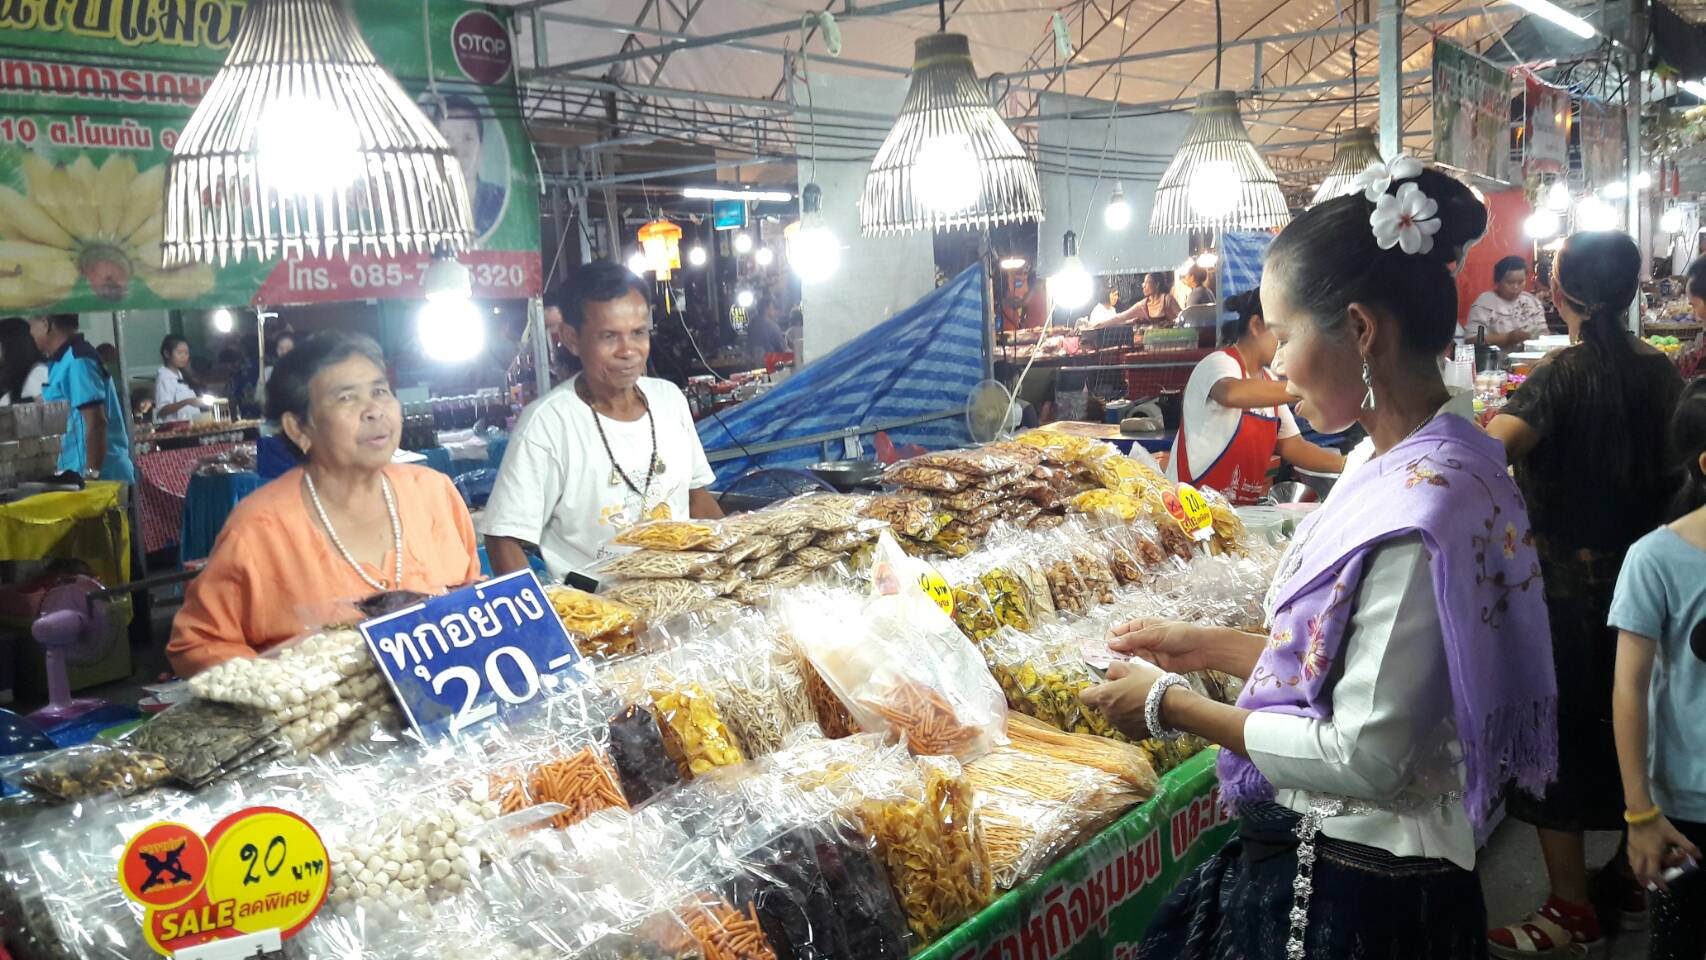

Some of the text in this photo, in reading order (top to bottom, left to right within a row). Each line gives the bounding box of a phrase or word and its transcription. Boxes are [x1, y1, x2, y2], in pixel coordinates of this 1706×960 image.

[458, 33, 506, 54] OTOP
[0, 60, 214, 105] ทางการเกษ
[350, 262, 525, 290] 085-75320
[379, 588, 544, 682] ทุกอย่าง
[240, 835, 287, 887] 20
[160, 889, 312, 942] SALE ลดพิเศษ
